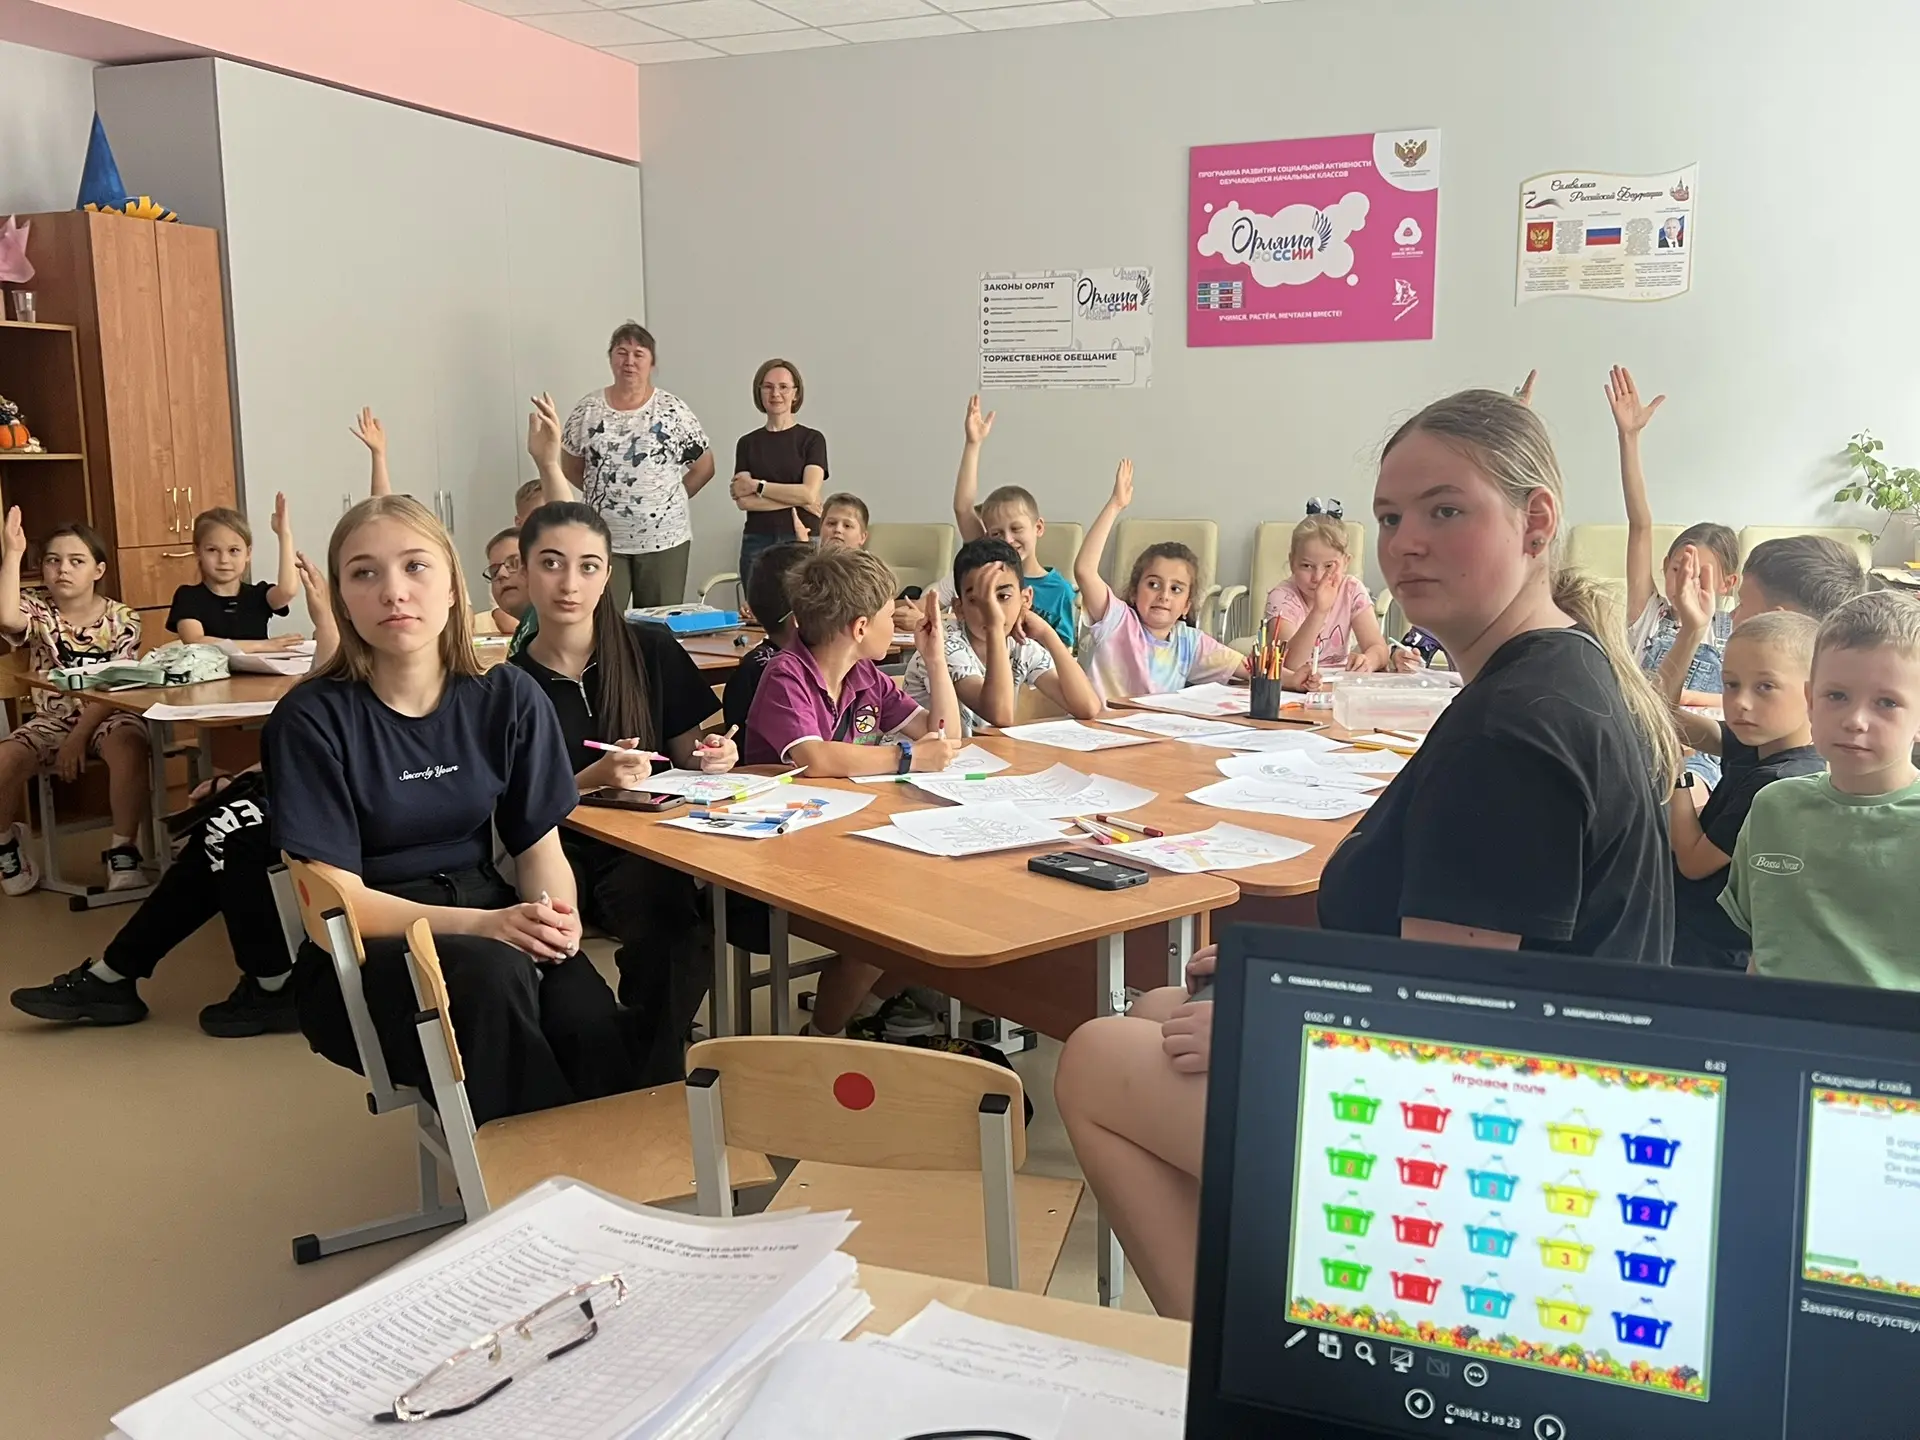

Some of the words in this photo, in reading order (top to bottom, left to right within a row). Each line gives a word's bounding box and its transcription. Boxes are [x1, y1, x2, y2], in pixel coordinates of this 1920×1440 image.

[1198, 168, 1240, 178] ПРОГРАММА
[1242, 166, 1276, 176] РАЗВИТИЯ
[1277, 162, 1324, 173] СОЦИАЛЬНОЙ
[1325, 160, 1372, 170] АКТИВНОСТИ
[1219, 175, 1272, 186] ОБУЧАЮЩИХСЯ
[1273, 172, 1316, 182] НАЧАЛЬНЫХ
[1316, 170, 1348, 179] КЛАССОВ
[1232, 216, 1314, 261] Орлята
[984, 282, 1022, 292] ЗАКОНЫ
[1025, 282, 1055, 290] ОРЛЯТ
[1077, 278, 1138, 310] Орлята
[1278, 311, 1312, 319] МЕЧТАЕМ
[1312, 310, 1342, 318] ВМЕСТЕ!
[984, 354, 1062, 362] ТОРЖЕСТВЕННОЕ
[1064, 353, 1118, 362] ОБЕЩАНИЕ
[1756, 856, 1780, 868] Bossa
[1452, 1072, 1509, 1092] Игровое
[1513, 1082, 1547, 1096] поле
[1810, 1070, 1877, 1090] Следующий
[1878, 1080, 1912, 1095] слайд
[1566, 1198, 1575, 1212] 2
[1640, 1206, 1651, 1221] 2
[1562, 1252, 1571, 1266] 3
[1638, 1263, 1649, 1278] 3
[1800, 1299, 1854, 1320] Заметки
[1634, 1326, 1646, 1339] 4
[1445, 1403, 1480, 1422] Слайд
[1481, 1411, 1490, 1423] 2
[1492, 1415, 1504, 1426] из
[1506, 1416, 1522, 1429] 23
